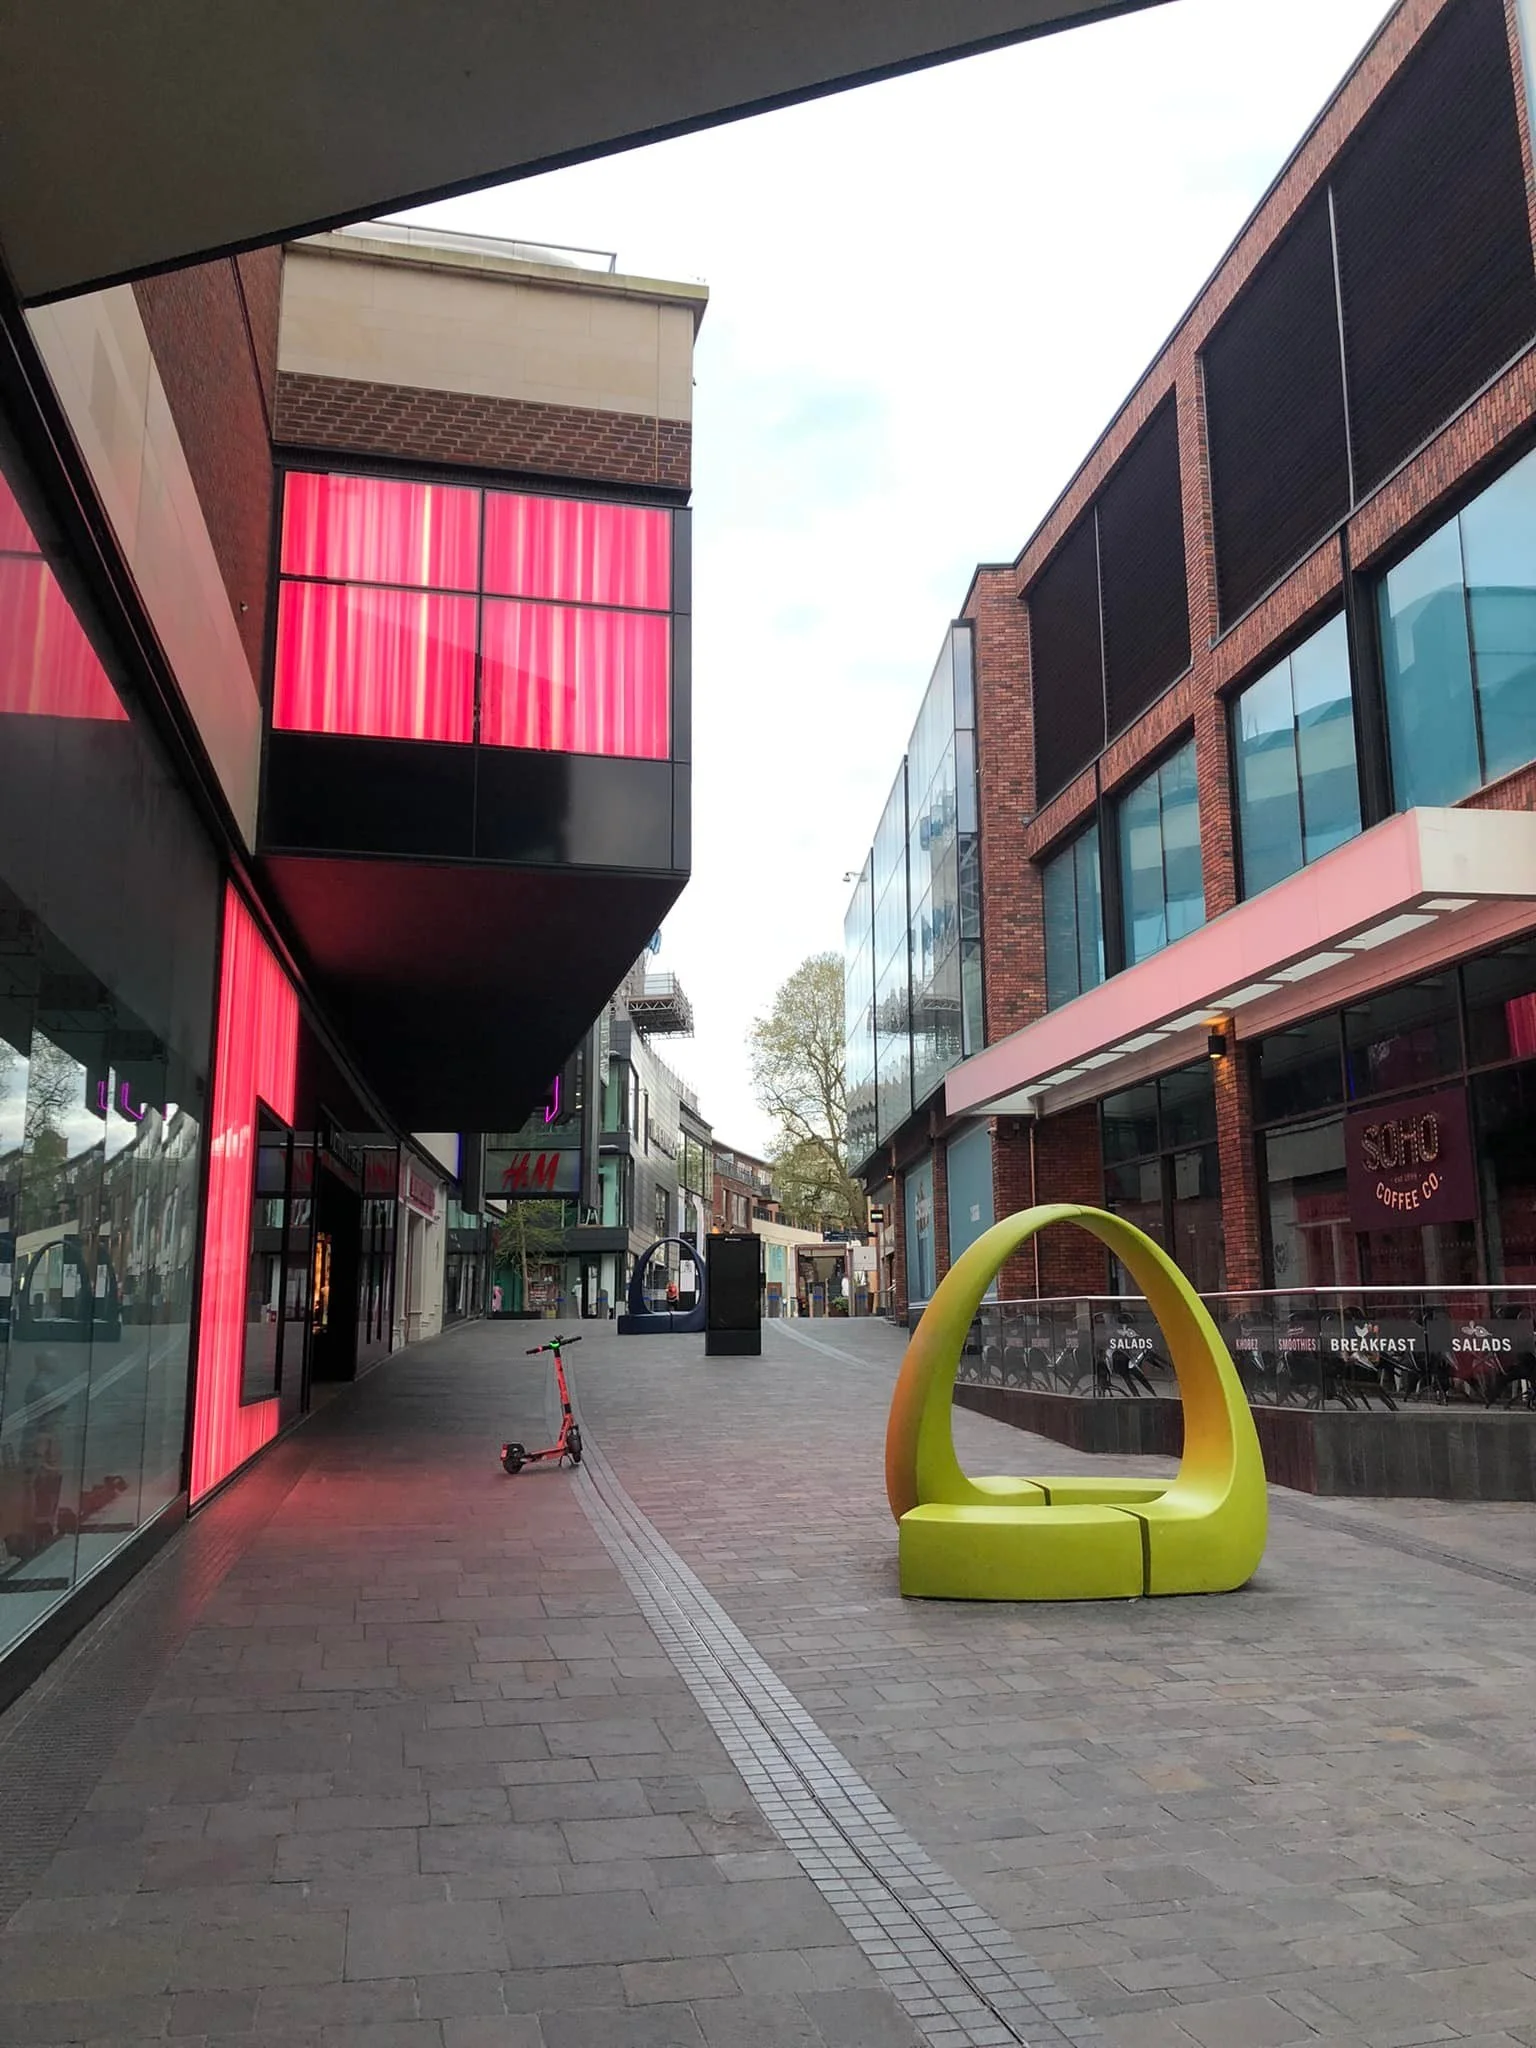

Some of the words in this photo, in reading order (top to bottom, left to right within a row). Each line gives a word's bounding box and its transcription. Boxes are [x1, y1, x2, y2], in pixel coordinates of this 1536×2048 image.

[1362, 1112, 1439, 1171] SOHO
[502, 1151, 560, 1192] H&M
[1376, 1181, 1420, 1211] COFFEE
[1422, 1172, 1443, 1200] CO.
[1109, 1338, 1153, 1350] SALADS
[1278, 1338, 1317, 1351] SMOOTHIES
[1330, 1338, 1416, 1352] BREAKFAST
[1452, 1338, 1512, 1352] SALADS
